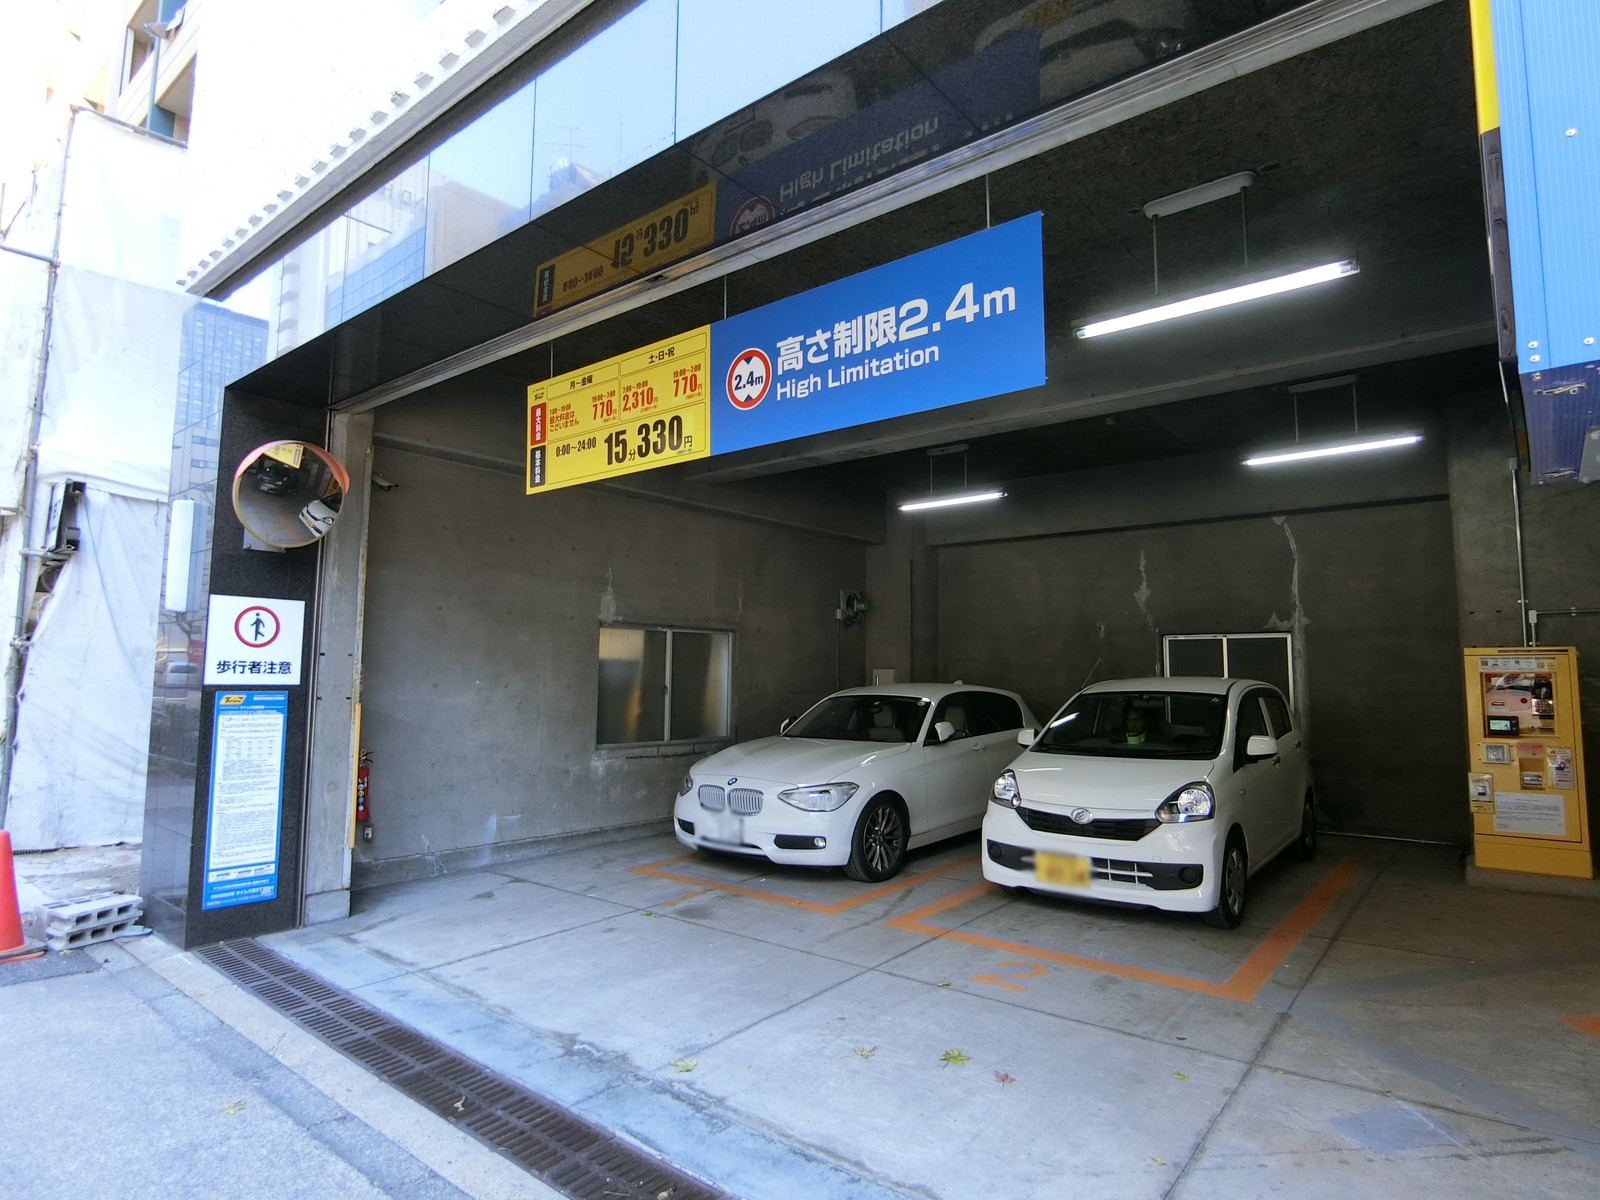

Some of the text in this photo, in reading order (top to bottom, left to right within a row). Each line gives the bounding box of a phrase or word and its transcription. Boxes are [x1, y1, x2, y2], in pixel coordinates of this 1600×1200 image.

[776, 282, 1016, 375] 高さ制限2.4m
[734, 370, 764, 391] 2.4m
[776, 345, 939, 401] High Limitation
[216, 660, 292, 675] 歩行者注意
